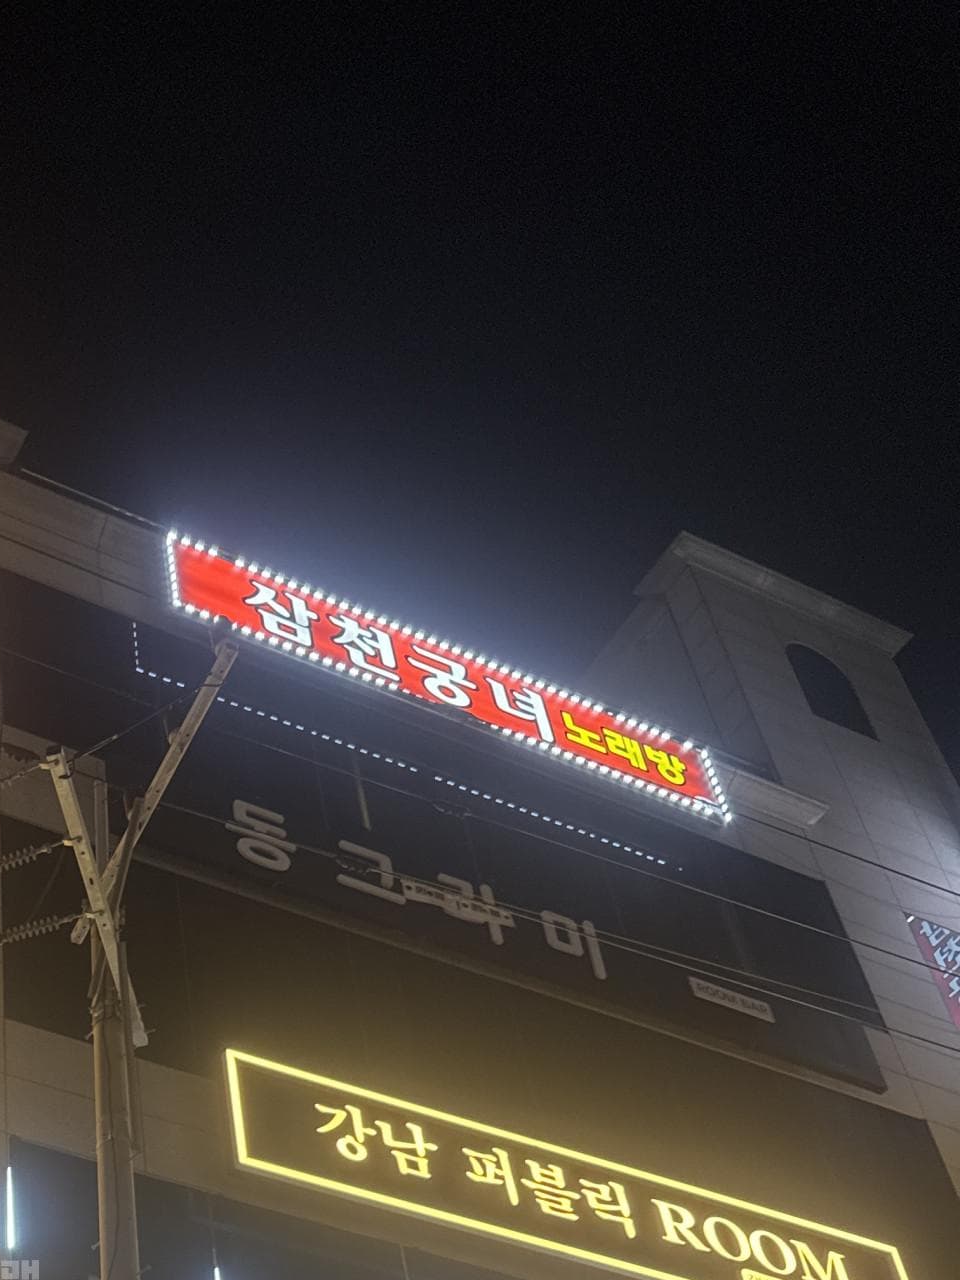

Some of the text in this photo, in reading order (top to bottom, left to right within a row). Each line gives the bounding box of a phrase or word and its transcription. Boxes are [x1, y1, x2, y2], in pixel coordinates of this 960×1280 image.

[244, 580, 687, 786] 삼천궁녀 노래방
[315, 1102, 439, 1179] 강남
[463, 1146, 637, 1239] 퍼블릭
